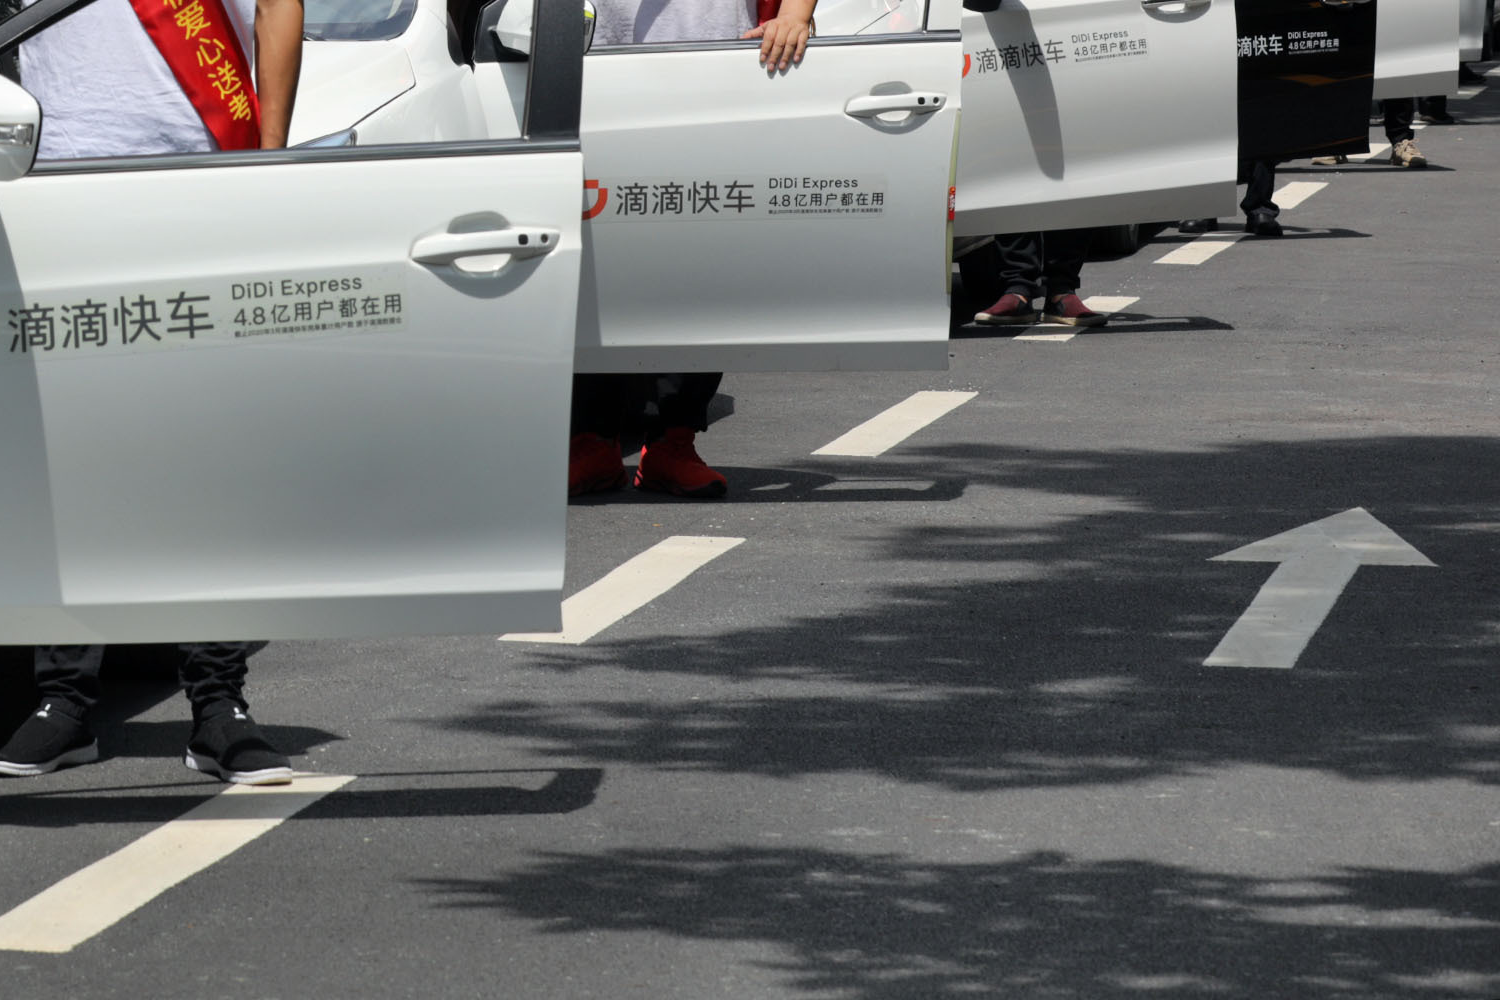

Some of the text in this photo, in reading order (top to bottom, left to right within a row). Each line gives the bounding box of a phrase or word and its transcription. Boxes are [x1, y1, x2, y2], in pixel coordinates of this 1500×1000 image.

[1072, 30, 1129, 44] DiDi Express
[1237, 34, 1283, 57] 滴快车
[1302, 30, 1328, 39] Express
[975, 40, 1066, 74] 滴滴快车
[768, 177, 859, 191] DiDi Express
[615, 180, 755, 216] 滴滴快车
[768, 192, 884, 208] 4.8亿用户都在用
[231, 276, 363, 300] DiDi Express
[233, 293, 402, 327] 4.8亿用户都在用
[8, 291, 214, 353] 滴滴快车
